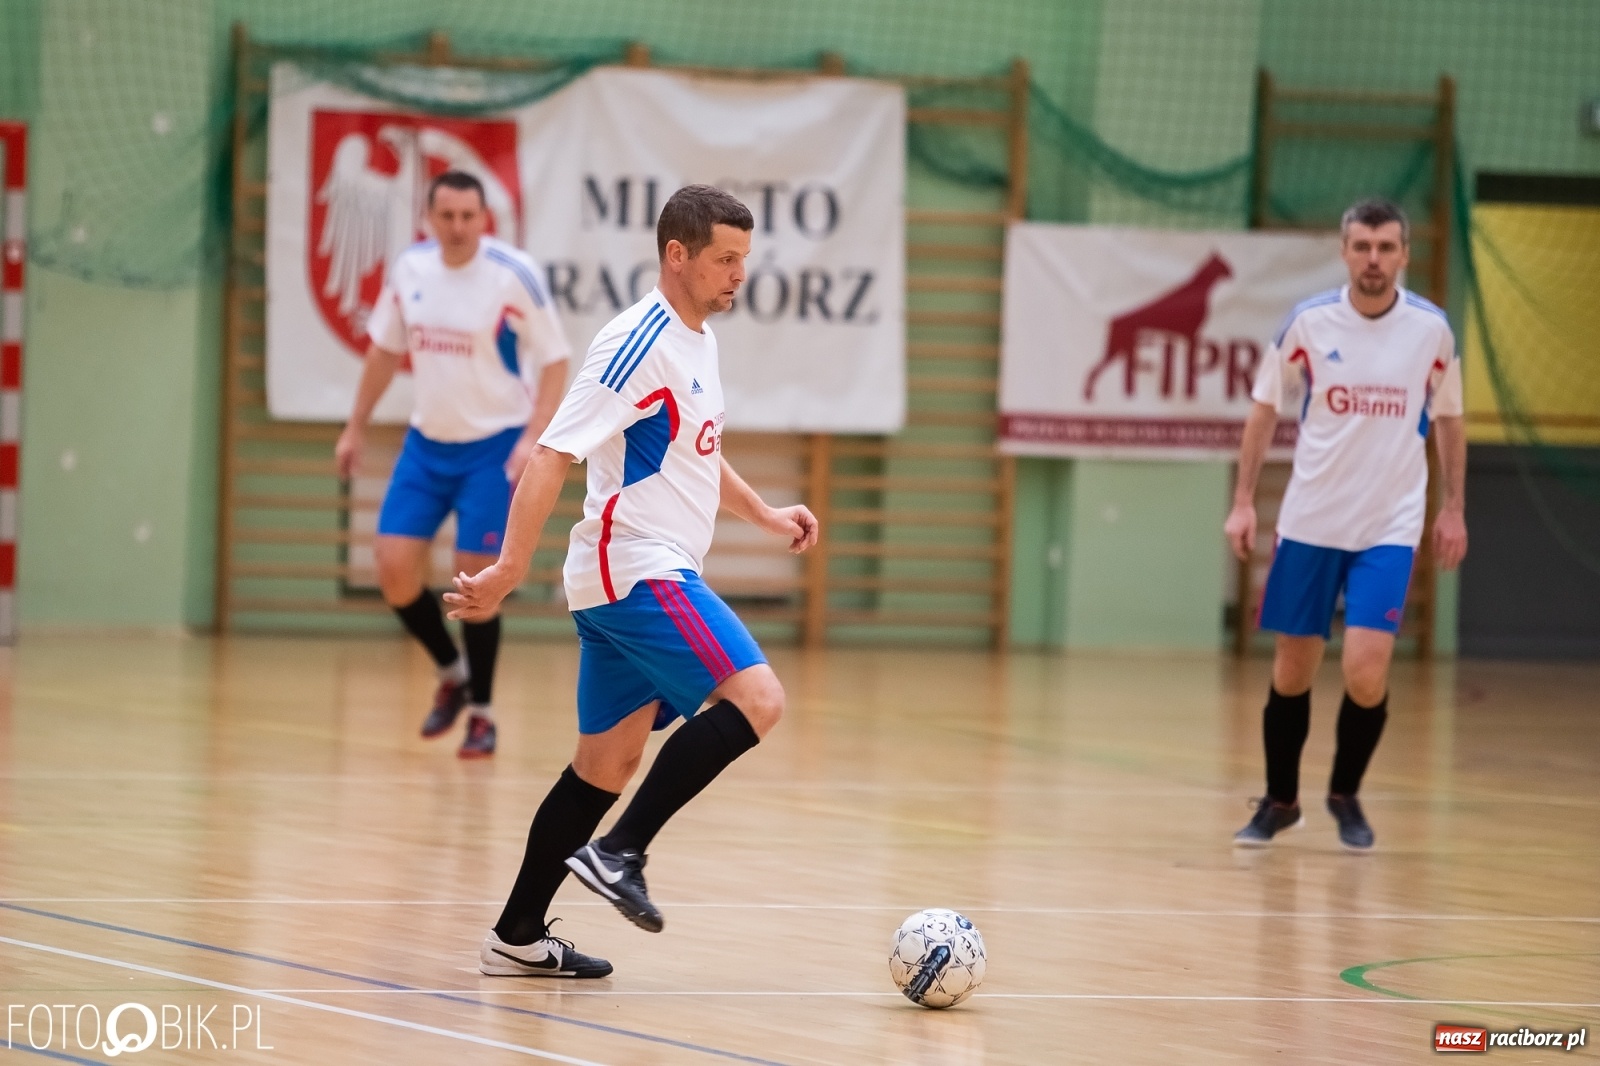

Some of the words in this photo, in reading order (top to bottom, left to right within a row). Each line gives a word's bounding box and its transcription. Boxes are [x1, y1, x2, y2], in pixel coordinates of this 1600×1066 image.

[583, 174, 840, 240] MITO
[545, 249, 879, 325] RACÓRZ
[1122, 334, 1259, 400] FIPR
[1326, 386, 1407, 418] Gianni
